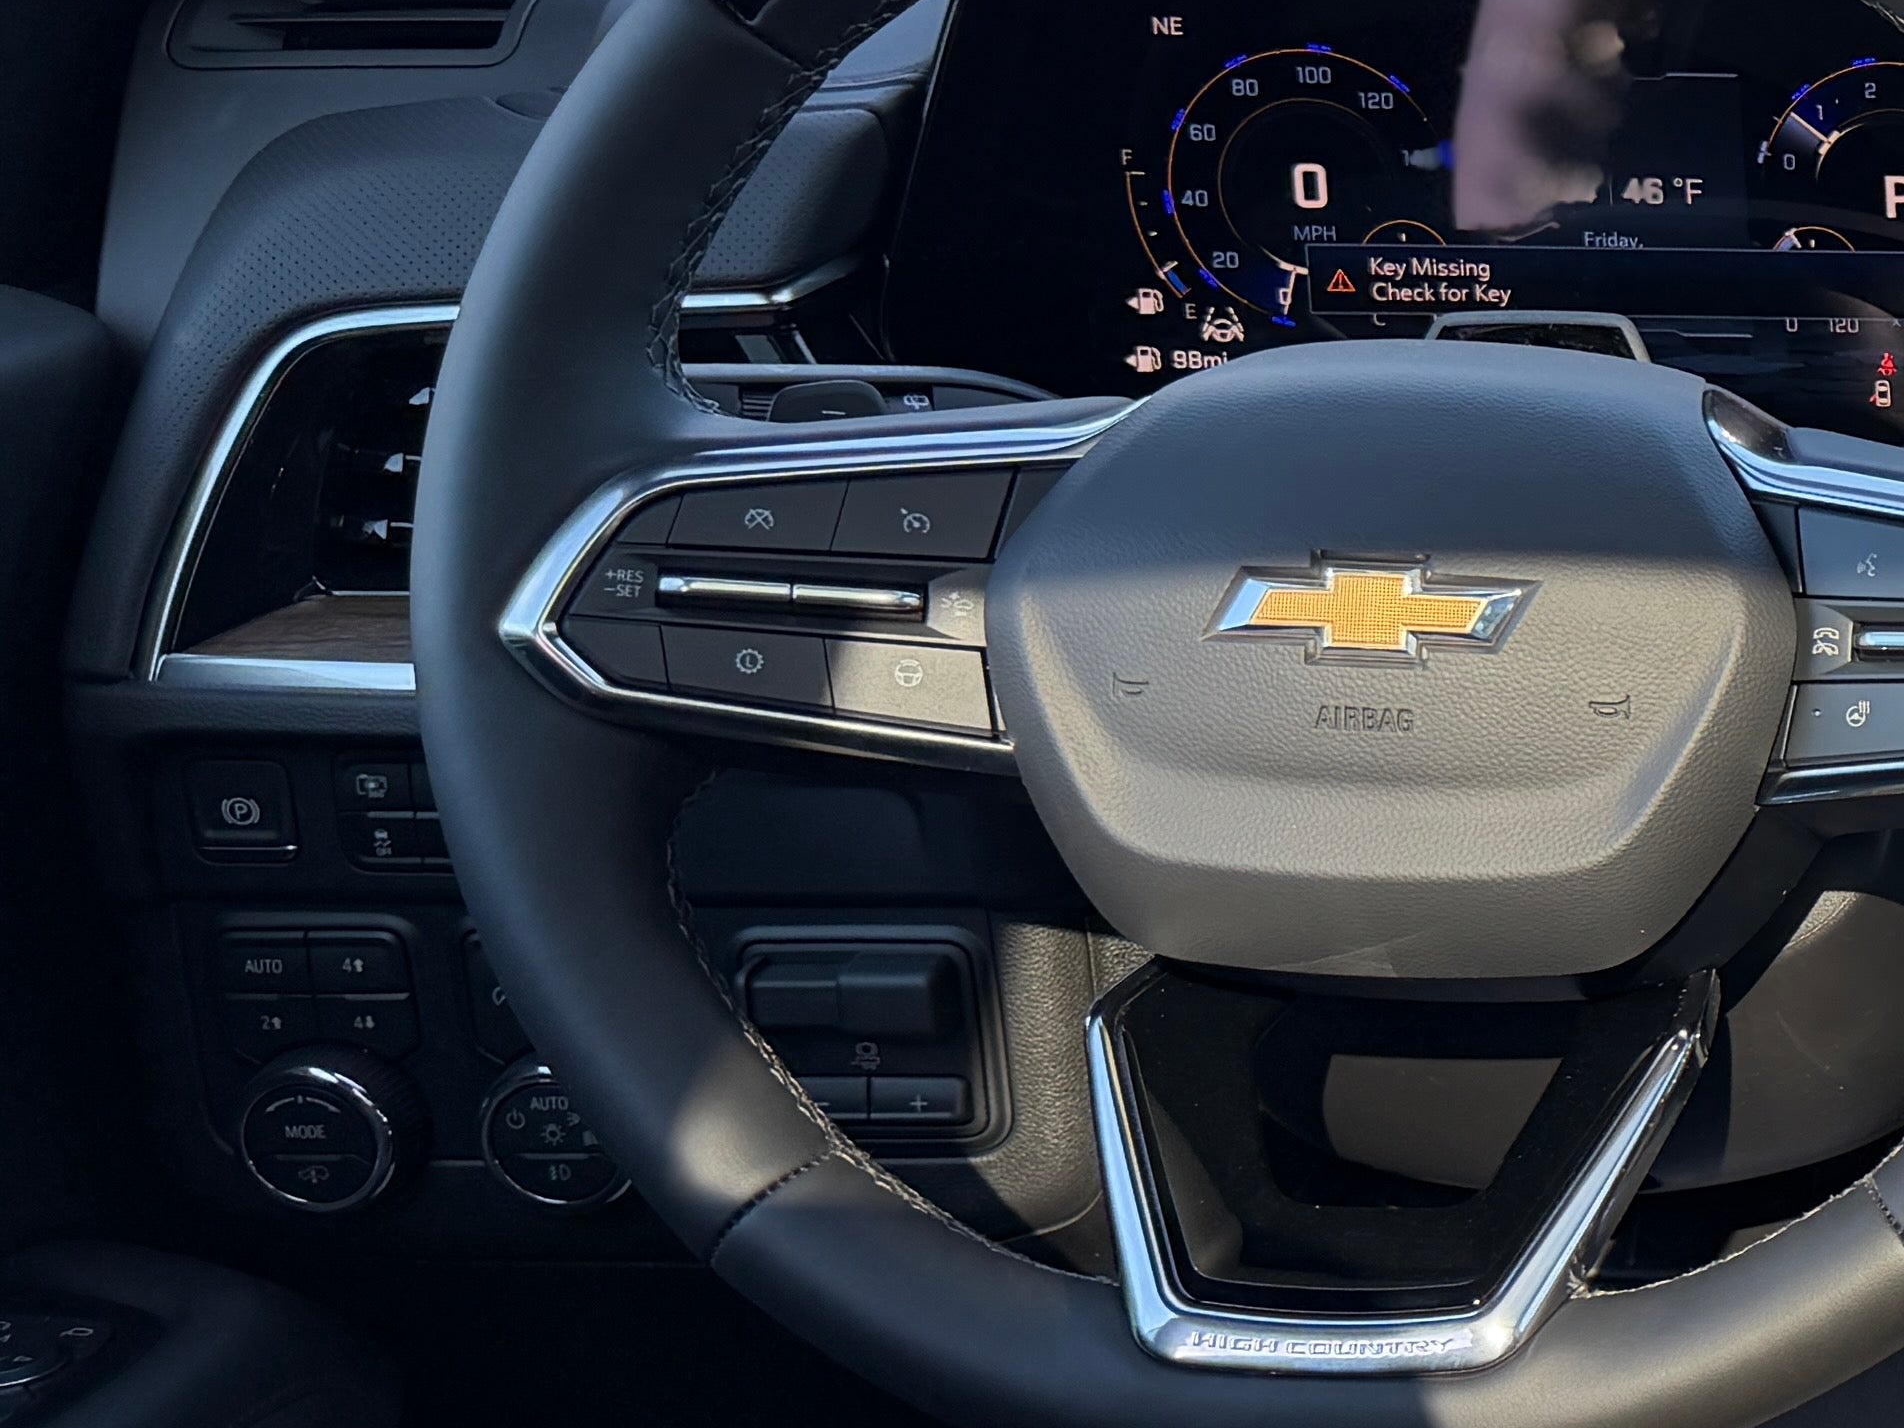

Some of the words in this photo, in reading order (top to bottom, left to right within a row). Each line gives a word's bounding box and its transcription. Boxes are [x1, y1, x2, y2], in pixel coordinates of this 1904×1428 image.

[1151, 16, 1184, 36] NE
[1296, 66, 1332, 85] 100
[1231, 78, 1258, 97] 80
[1864, 82, 1877, 99] 2
[1358, 92, 1394, 111] 120
[1815, 104, 1825, 121] 1
[1189, 124, 1217, 142] 60
[1120, 149, 1133, 165] F
[1782, 153, 1796, 171] 0
[1291, 162, 1329, 209] 0
[1622, 177, 1664, 205] 46
[1181, 189, 1209, 208] 40
[1293, 225, 1337, 242] MPH
[1212, 251, 1239, 269] 20
[1369, 257, 1406, 280] Key
[1412, 258, 1491, 283] Missing
[1370, 282, 1436, 303] Check
[1439, 284, 1470, 303] for
[1474, 286, 1512, 309] Key
[1184, 303, 1197, 319] E
[1313, 703, 1415, 734] AIRBAG
[244, 959, 283, 974] AUTO
[529, 1095, 569, 1112] AUTO
[284, 1124, 327, 1140] MODE
[1189, 1330, 1280, 1355] HIGH
[1285, 1336, 1455, 1357] COUNTRY
